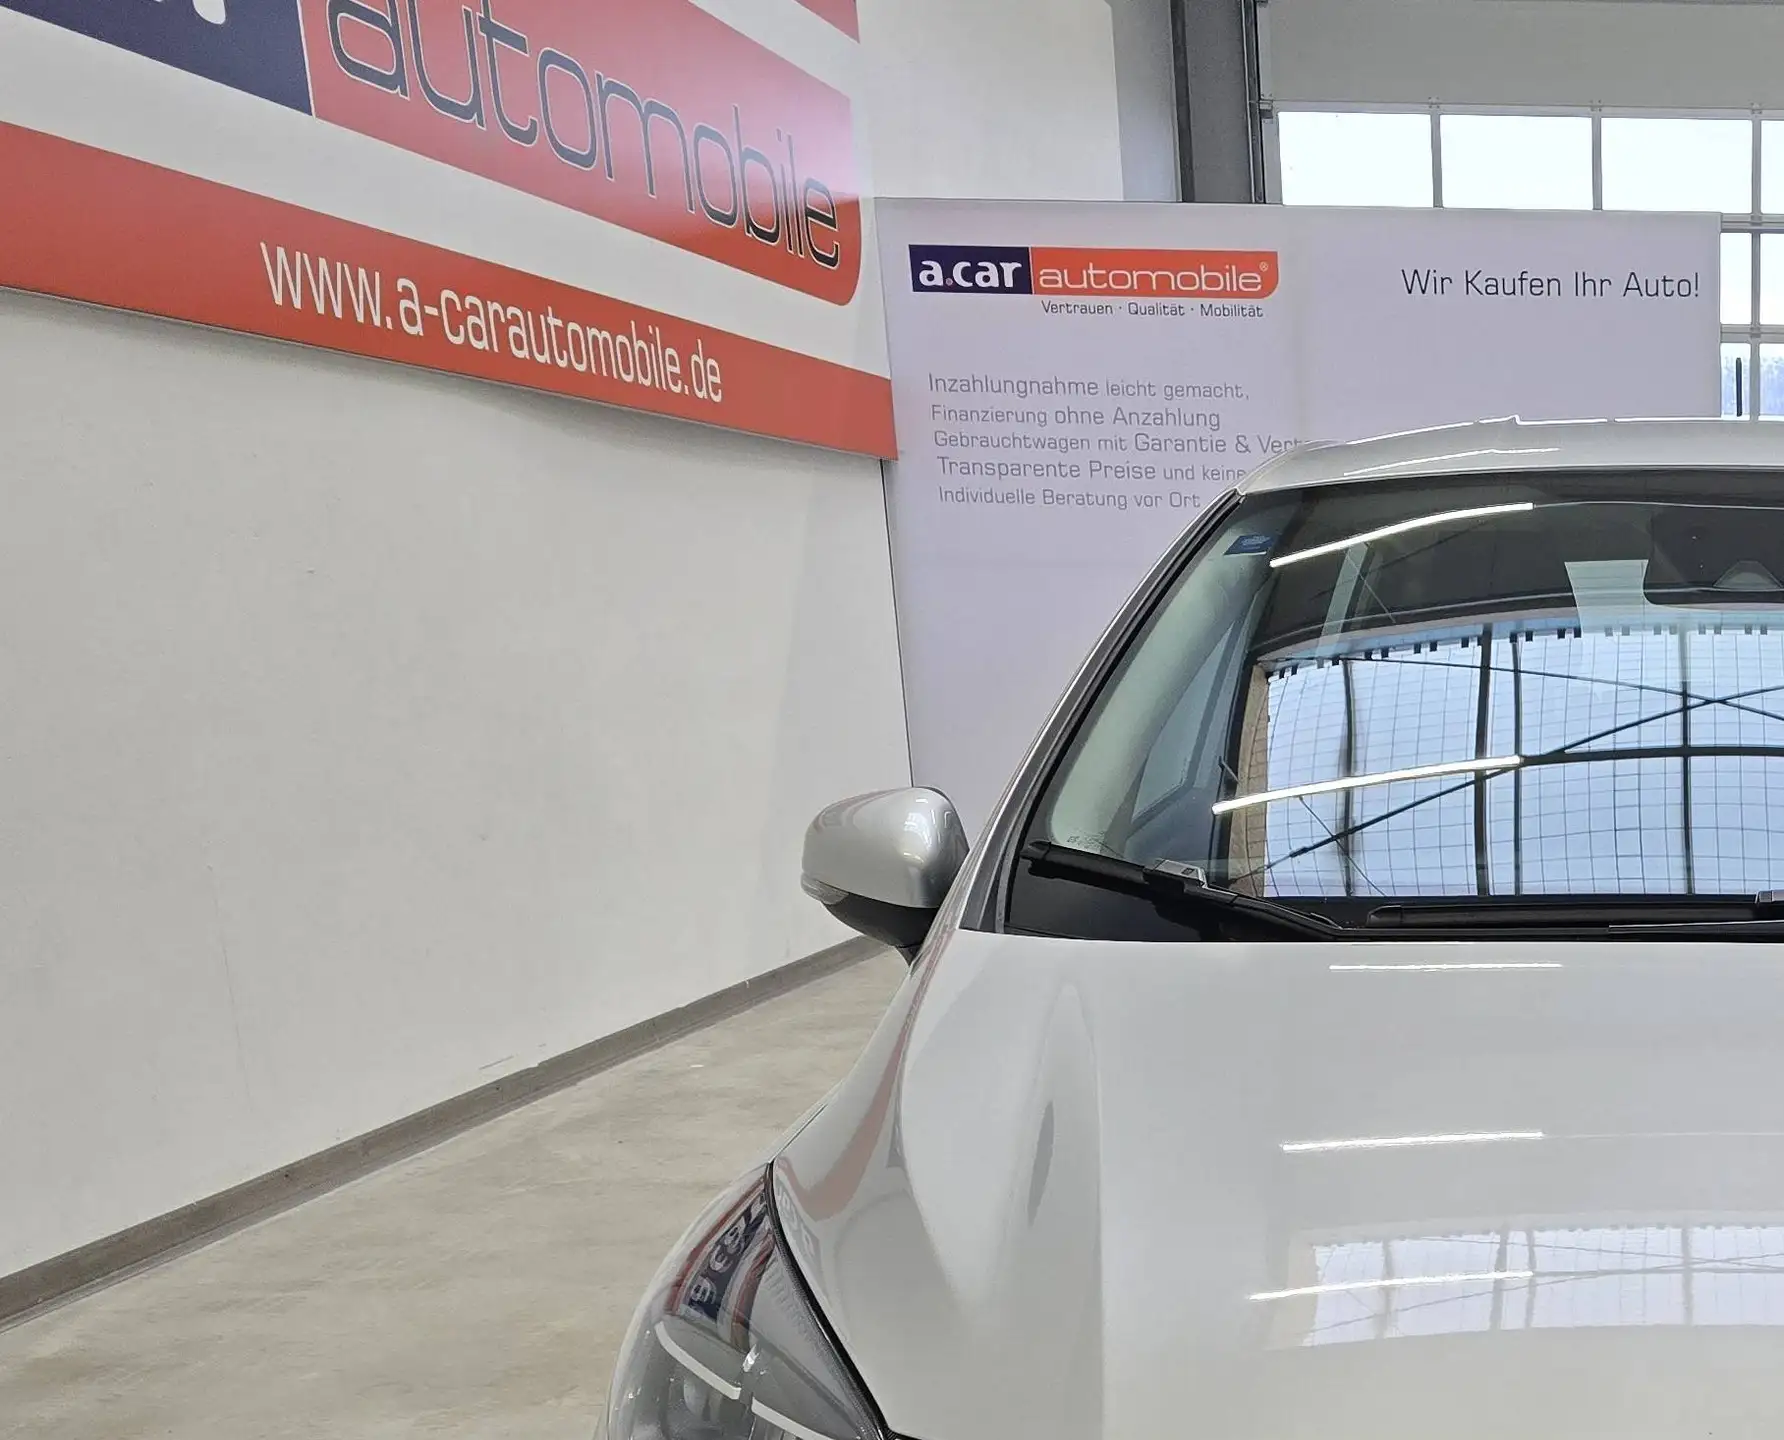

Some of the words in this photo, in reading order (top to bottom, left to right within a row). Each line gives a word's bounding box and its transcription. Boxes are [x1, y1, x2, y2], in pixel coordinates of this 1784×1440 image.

[328, 0, 841, 271] automobile
[918, 259, 1023, 290] a.car
[1400, 268, 1453, 296] Wir
[1465, 269, 1562, 297] Kaufen
[1574, 271, 1613, 297] Ihr
[1622, 271, 1700, 298] Auto!
[260, 241, 724, 404] www.a-carautomobile.de
[1041, 299, 1114, 316] Vertrauen
[1127, 300, 1186, 318] Qualität
[1200, 302, 1264, 319] Mobilität
[928, 372, 1100, 399] Inzahlungnahme
[1105, 379, 1157, 397] leicht
[1163, 381, 1250, 401] gemacht,
[930, 404, 1048, 428] Finanzierung
[1054, 405, 1105, 426] ohne
[1112, 406, 1221, 431] Anzahlung
[933, 430, 1091, 454] Gebrauchtwagen
[1097, 435, 1128, 451] mit
[1134, 432, 1227, 453] Garantie
[1234, 434, 1251, 454] &
[936, 456, 1081, 480] Transparente
[1089, 460, 1156, 480] Preise
[1163, 464, 1195, 480] und
[938, 486, 1036, 505] Individuelle
[1042, 488, 1128, 511] Beratung
[1133, 494, 1163, 508] vor
[1169, 491, 1200, 508] Ort
